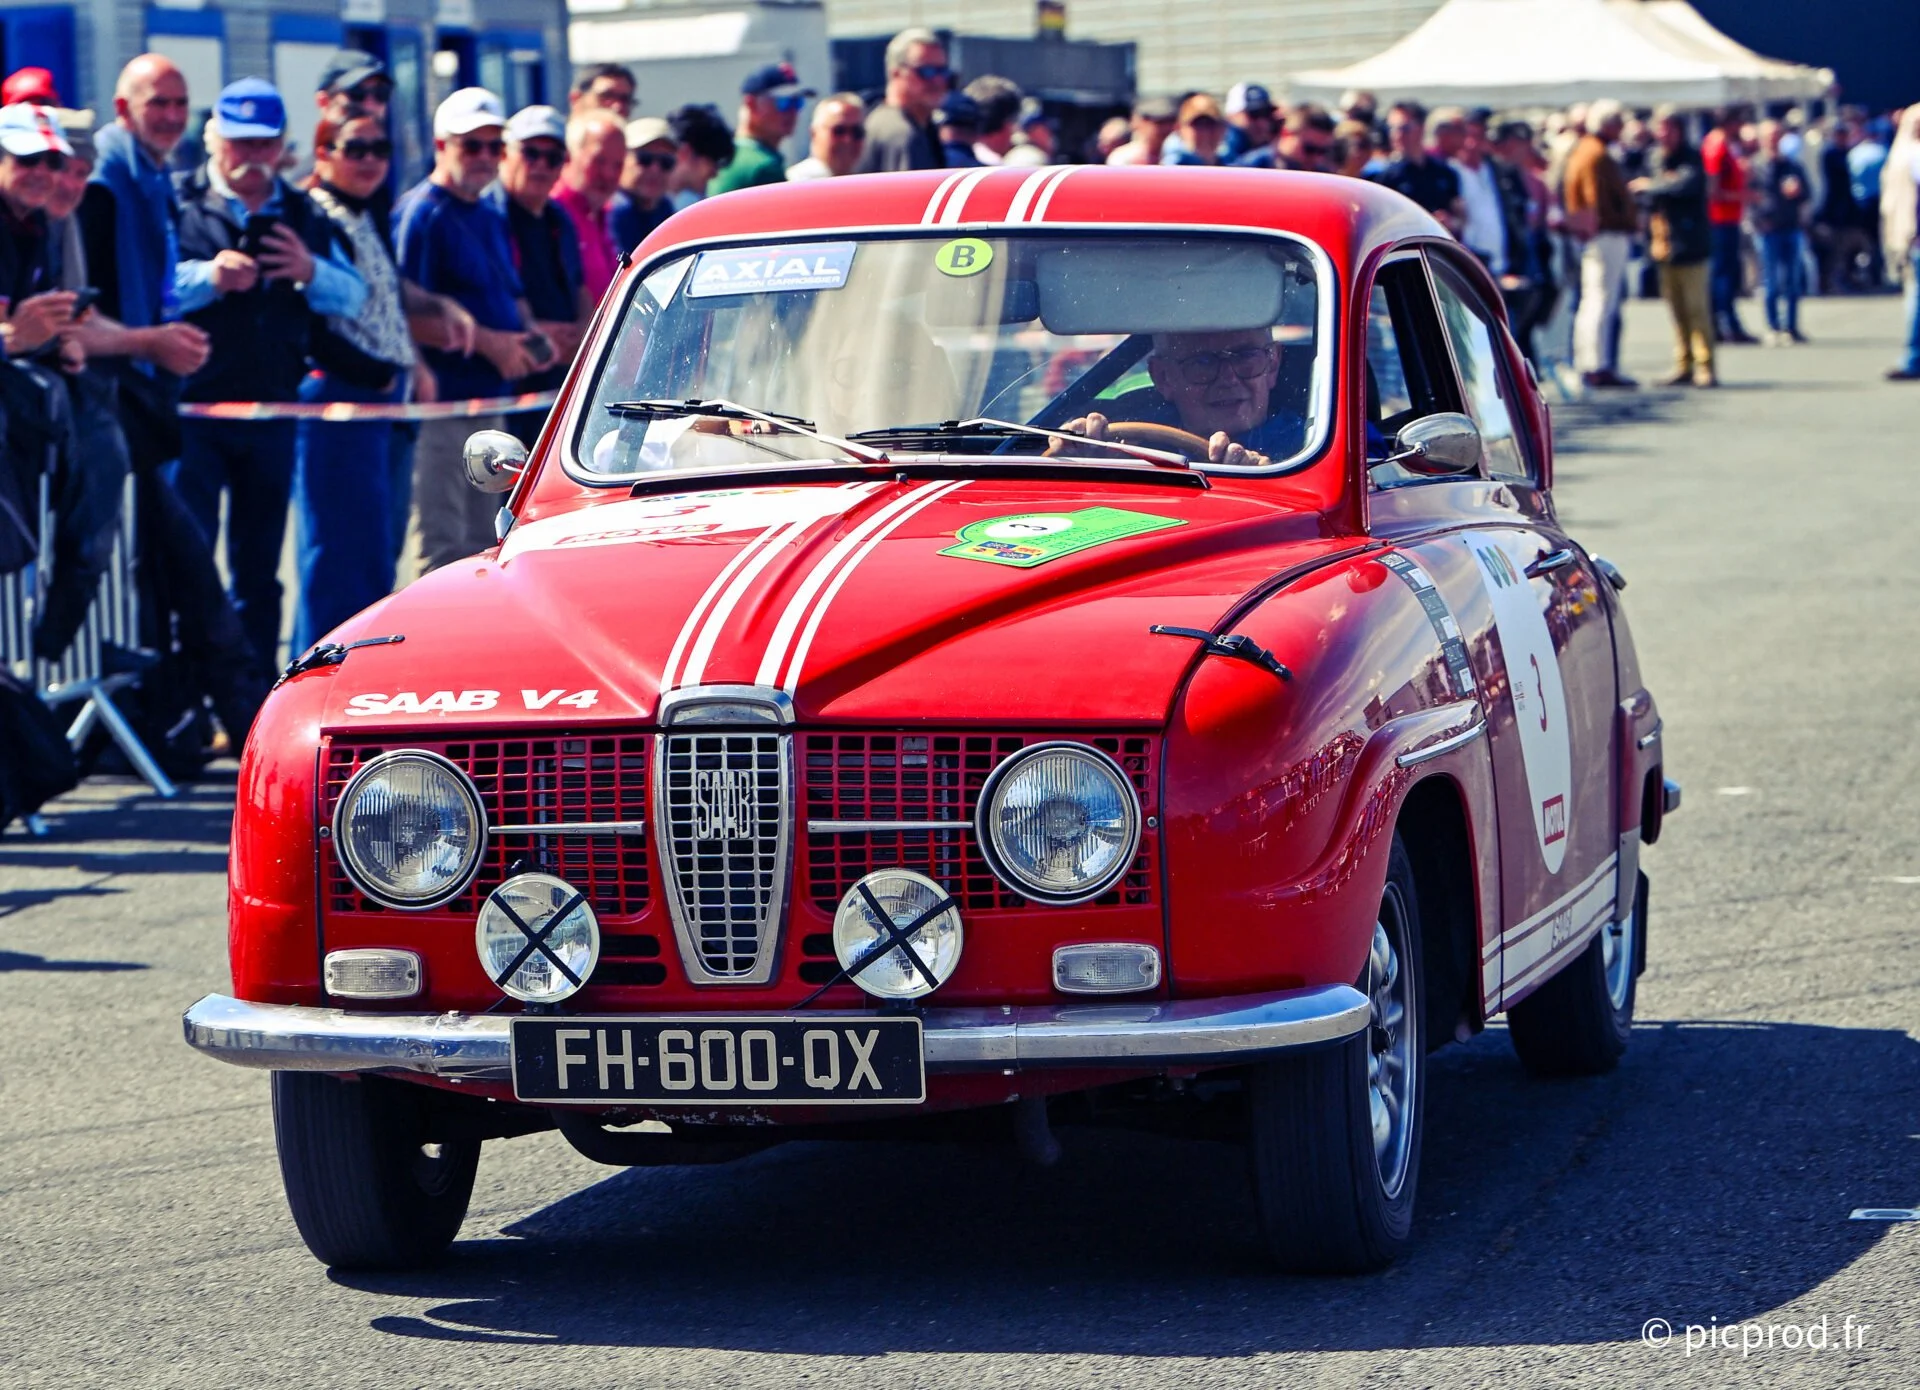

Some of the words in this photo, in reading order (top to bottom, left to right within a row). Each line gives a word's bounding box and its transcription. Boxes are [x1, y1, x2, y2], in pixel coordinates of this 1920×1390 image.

[696, 256, 841, 283] AXIAL
[949, 245, 976, 268] B
[768, 276, 840, 287] CARROSSIER
[344, 690, 500, 716] SAAB
[521, 689, 599, 710] V4
[1530, 653, 1547, 732] 3
[697, 770, 750, 840] SAAB
[555, 1029, 882, 1092] FH-600-QX
